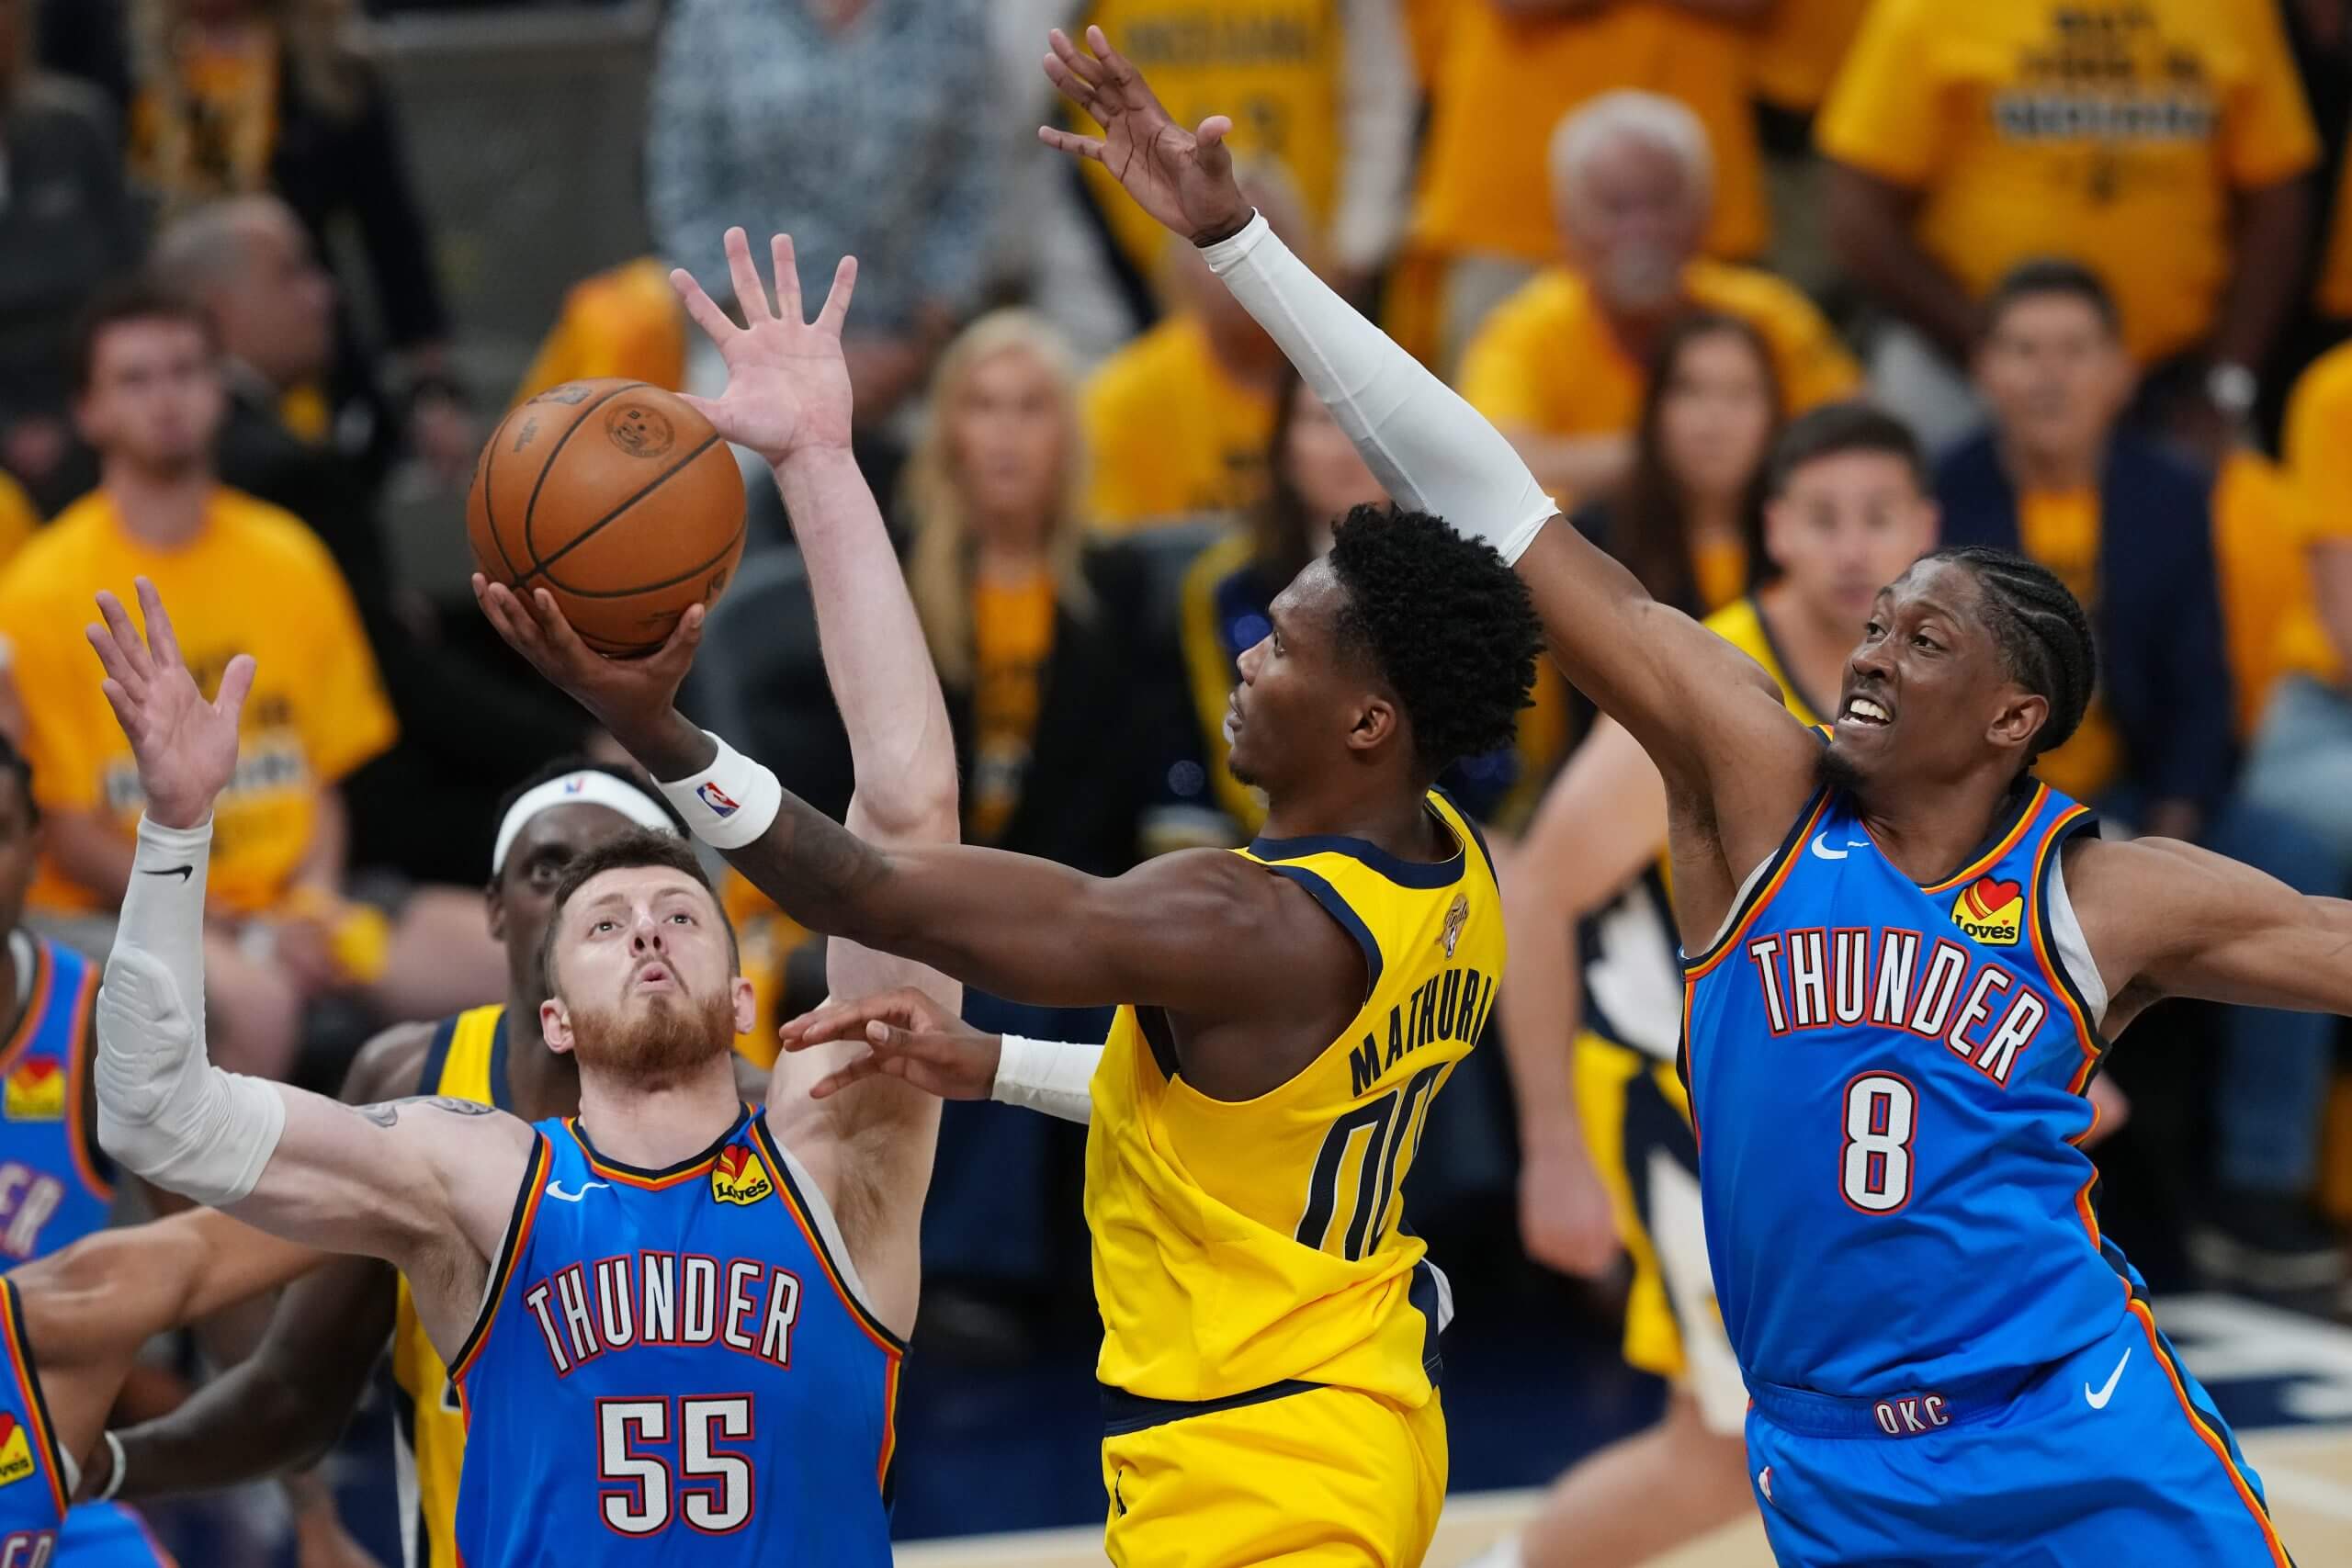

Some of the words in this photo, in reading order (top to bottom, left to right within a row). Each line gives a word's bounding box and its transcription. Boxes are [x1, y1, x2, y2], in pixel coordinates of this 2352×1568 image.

[1348, 967, 1499, 1099] MATHURI
[1747, 926, 2049, 1089] THUNDER
[1838, 1069, 1919, 1216] 8
[525, 1248, 803, 1379] THUNDER
[594, 1392, 755, 1539] 55
[1874, 1393, 1950, 1437] OKC
